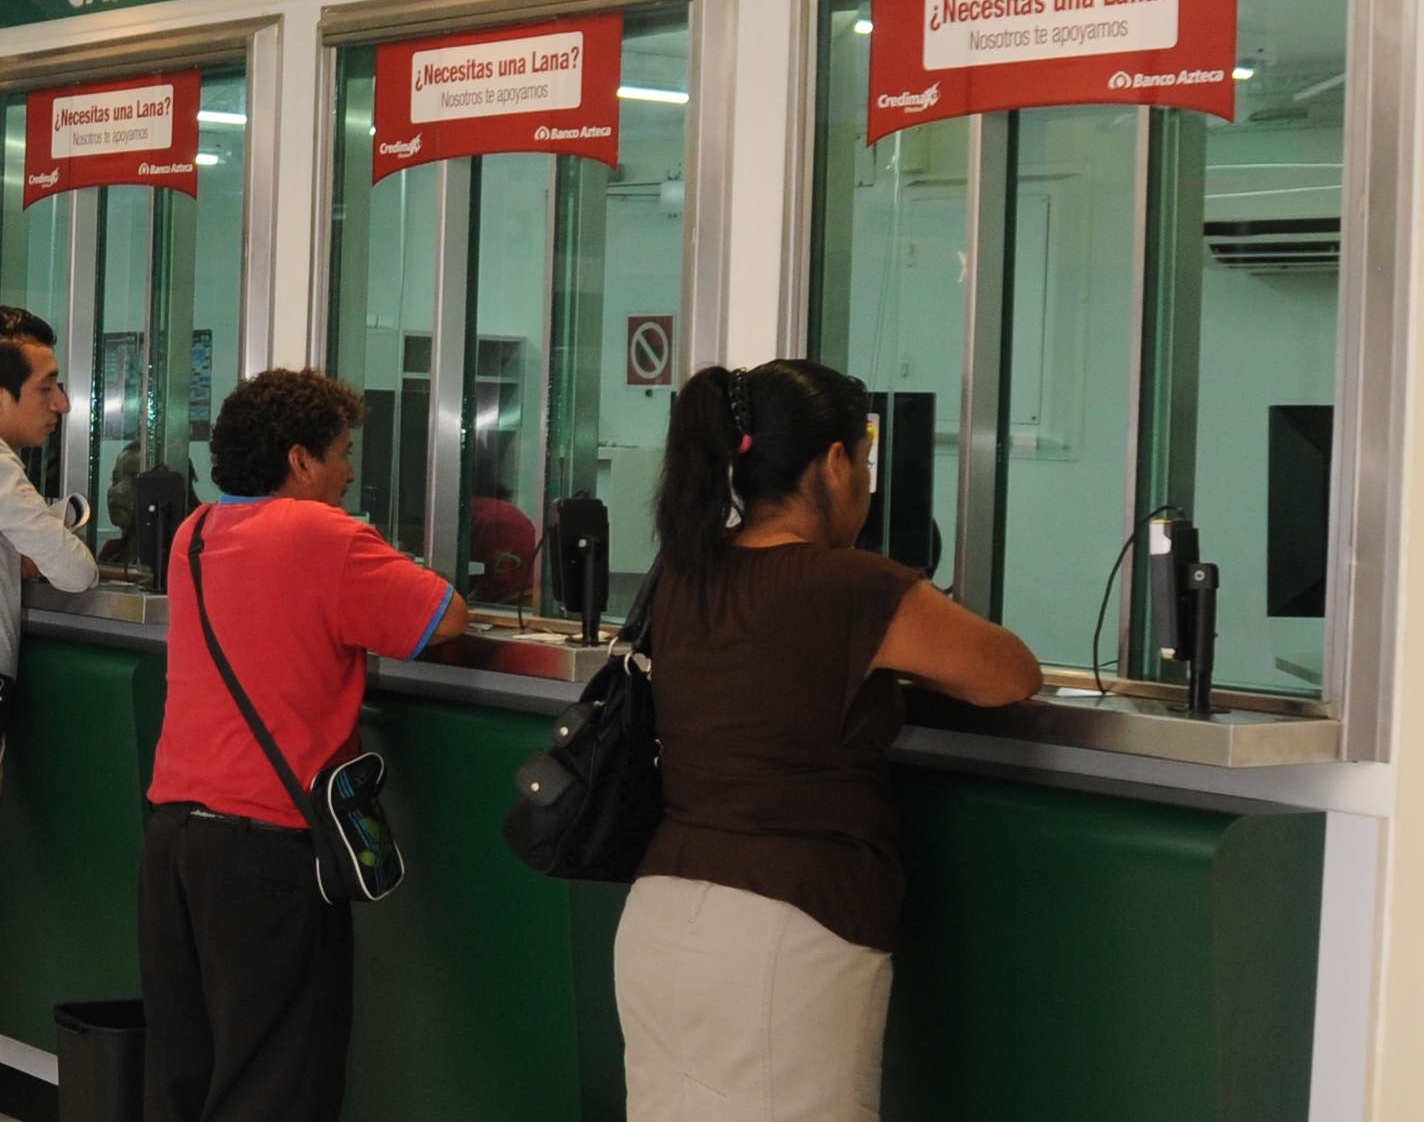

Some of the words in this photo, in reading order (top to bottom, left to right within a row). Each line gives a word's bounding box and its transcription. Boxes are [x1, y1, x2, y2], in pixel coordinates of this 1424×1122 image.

[969, 30, 1030, 51] Nosotros
[1035, 27, 1047, 45] te
[1052, 19, 1129, 47] apoyamos
[415, 59, 493, 91] ¿Necesitas
[498, 57, 525, 75] una
[532, 46, 580, 73] Lana?
[1133, 73, 1176, 88] Banco
[1176, 69, 1225, 84] Azteca
[441, 90, 483, 108] Nosotros
[485, 89, 495, 103] te
[497, 84, 549, 106] apoyamos
[55, 105, 110, 132] ¿Necesitas
[113, 105, 133, 121] una
[137, 96, 171, 118] Lana?
[550, 128, 579, 139] Banco
[580, 126, 612, 137] Azteca
